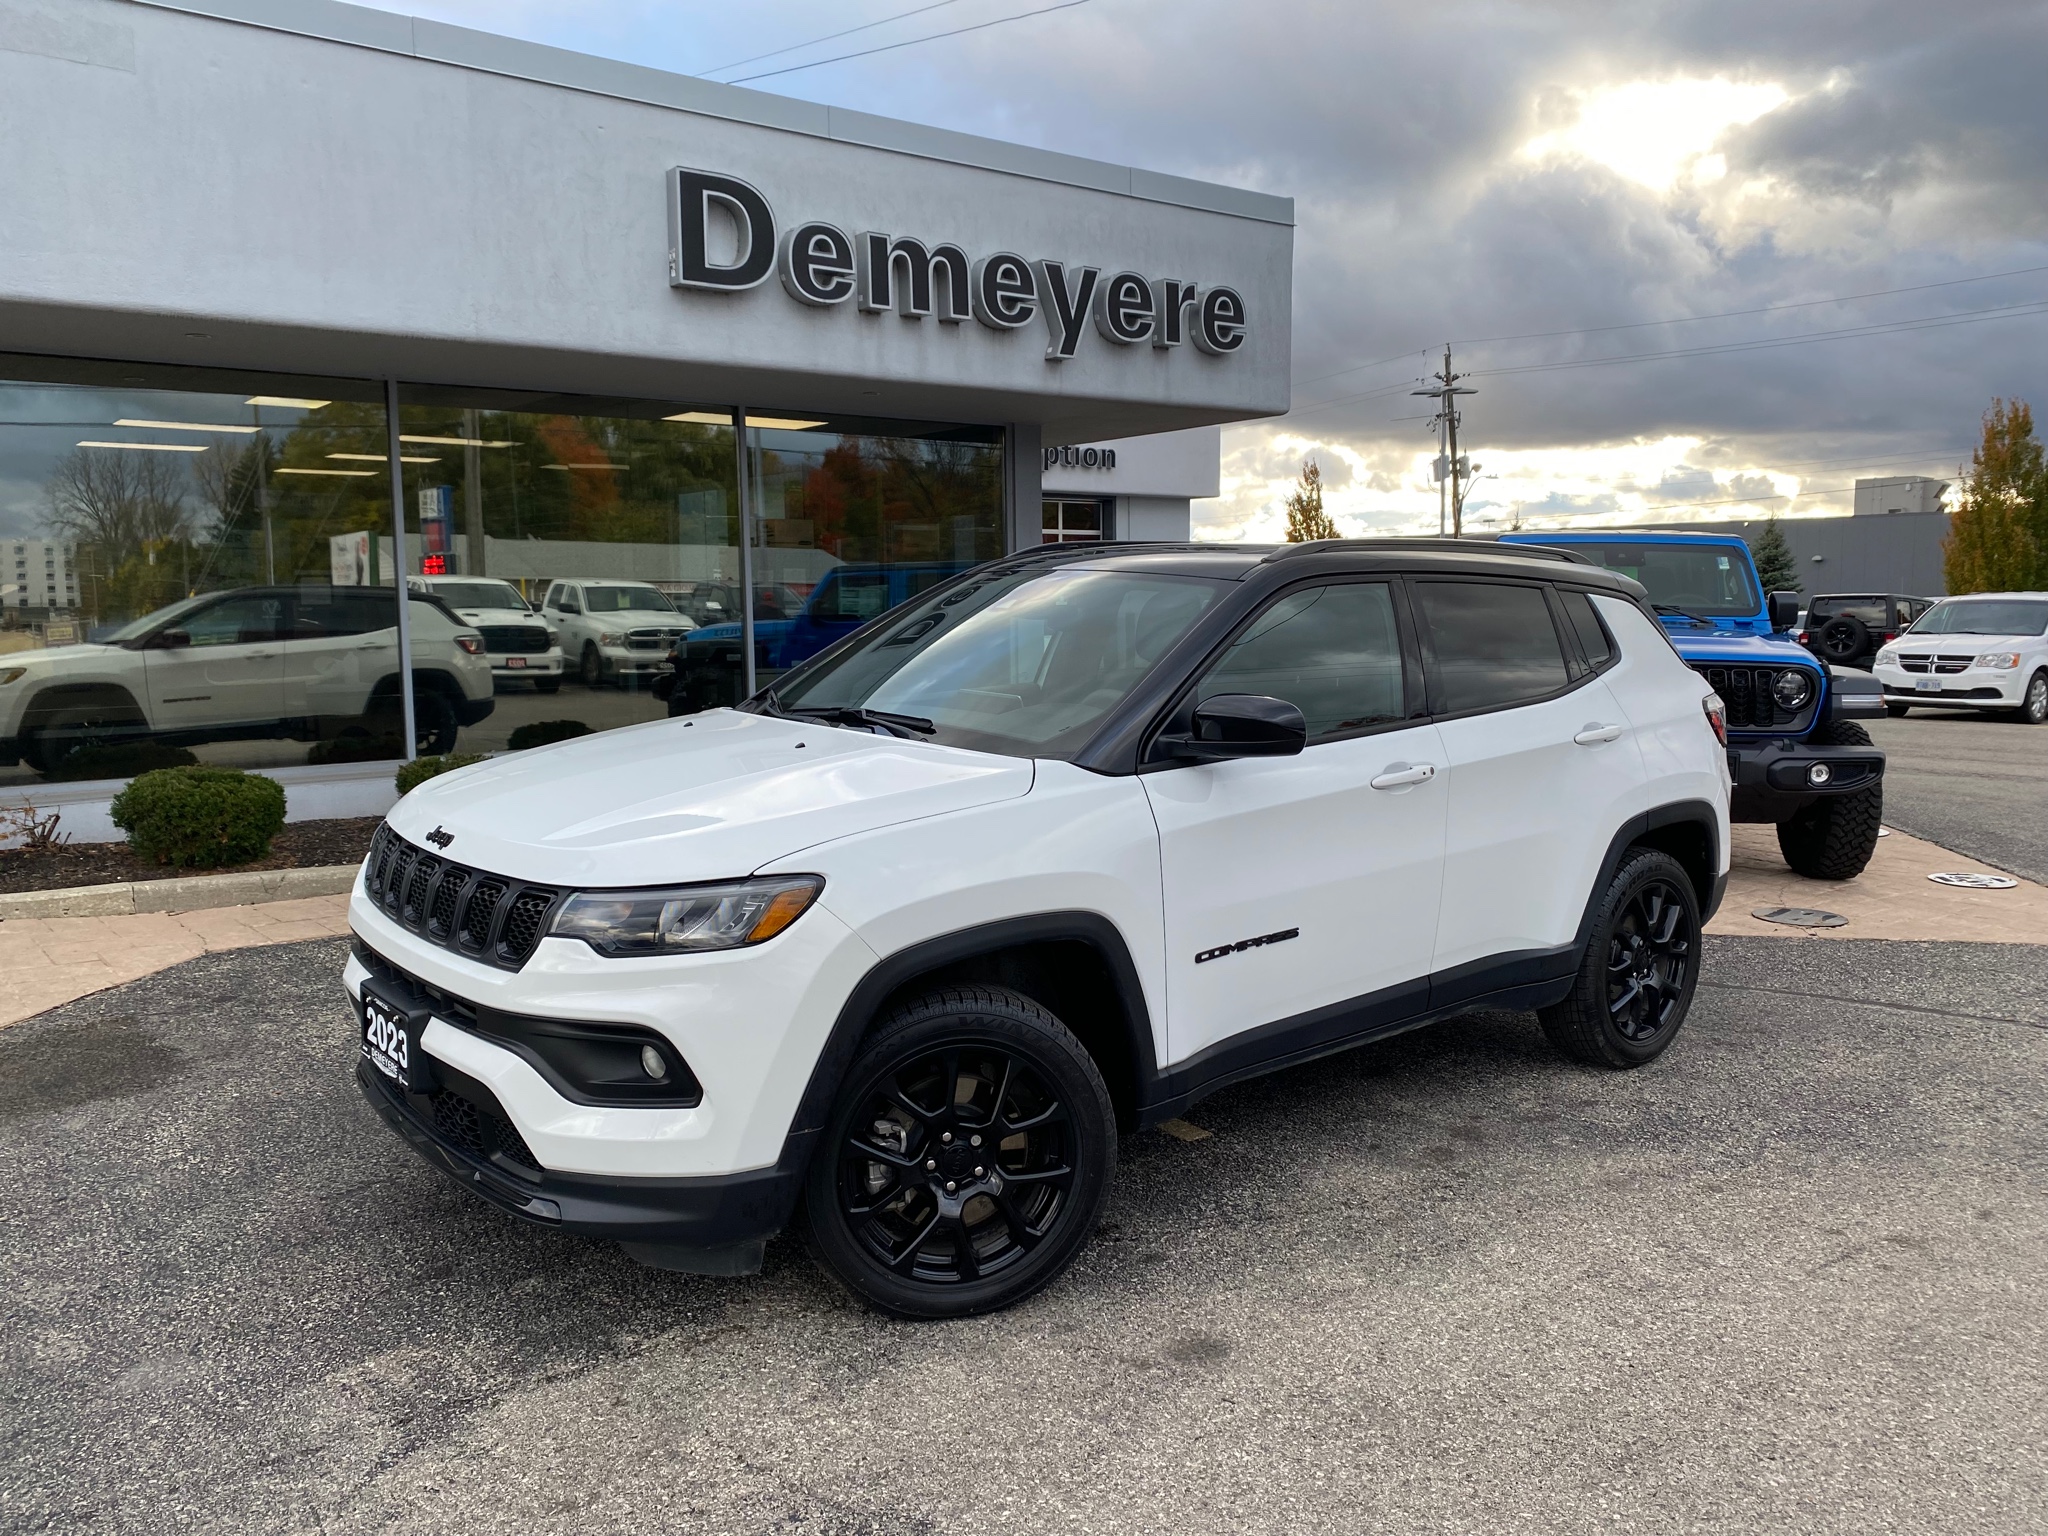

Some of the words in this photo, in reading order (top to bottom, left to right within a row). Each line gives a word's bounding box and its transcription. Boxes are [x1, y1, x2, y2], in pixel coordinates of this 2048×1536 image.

[667, 165, 1247, 361] Demeyere
[1041, 445, 1117, 472] ption
[425, 825, 455, 850] Jeep
[1195, 927, 1299, 964] COMPASS
[366, 1006, 408, 1069] 2023
[371, 1047, 398, 1075] DEMEYERE
